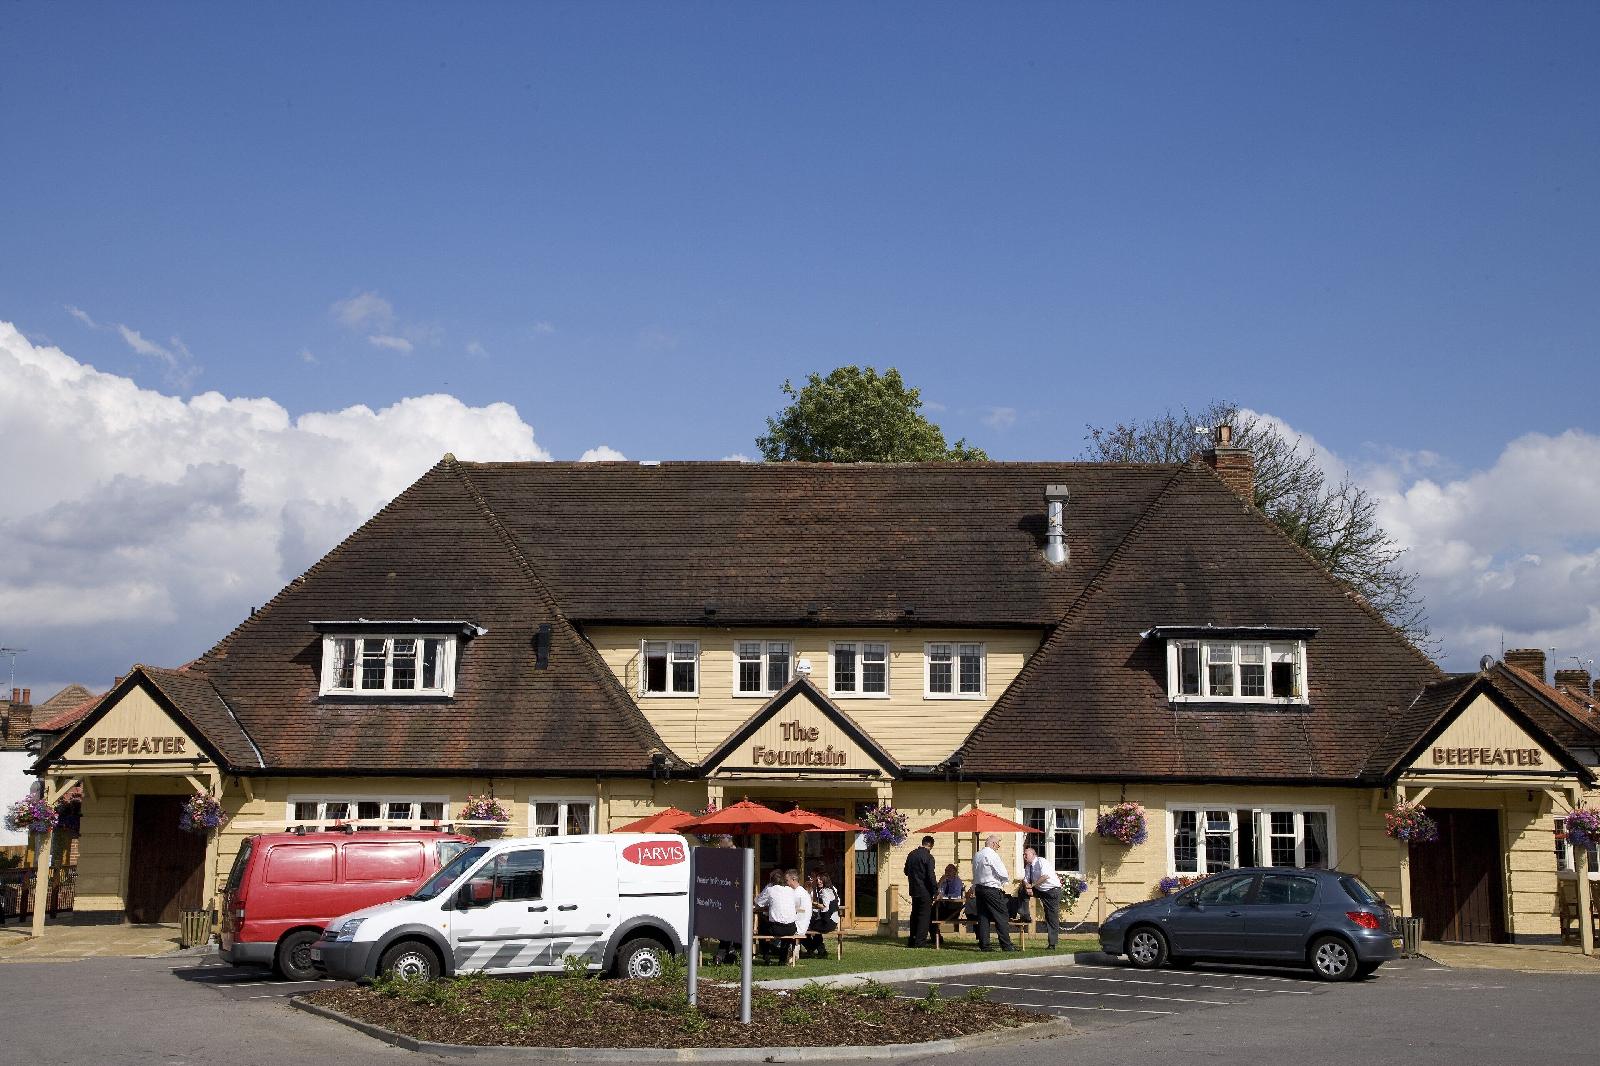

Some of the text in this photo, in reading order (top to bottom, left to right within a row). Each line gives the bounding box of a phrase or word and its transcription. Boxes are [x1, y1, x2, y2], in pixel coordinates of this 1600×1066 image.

[780, 720, 819, 742] The
[83, 737, 186, 755] BEEFEATER
[753, 744, 847, 766] Fountain
[1432, 747, 1543, 766] BEEFEATER
[637, 846, 683, 864] JARVIS
